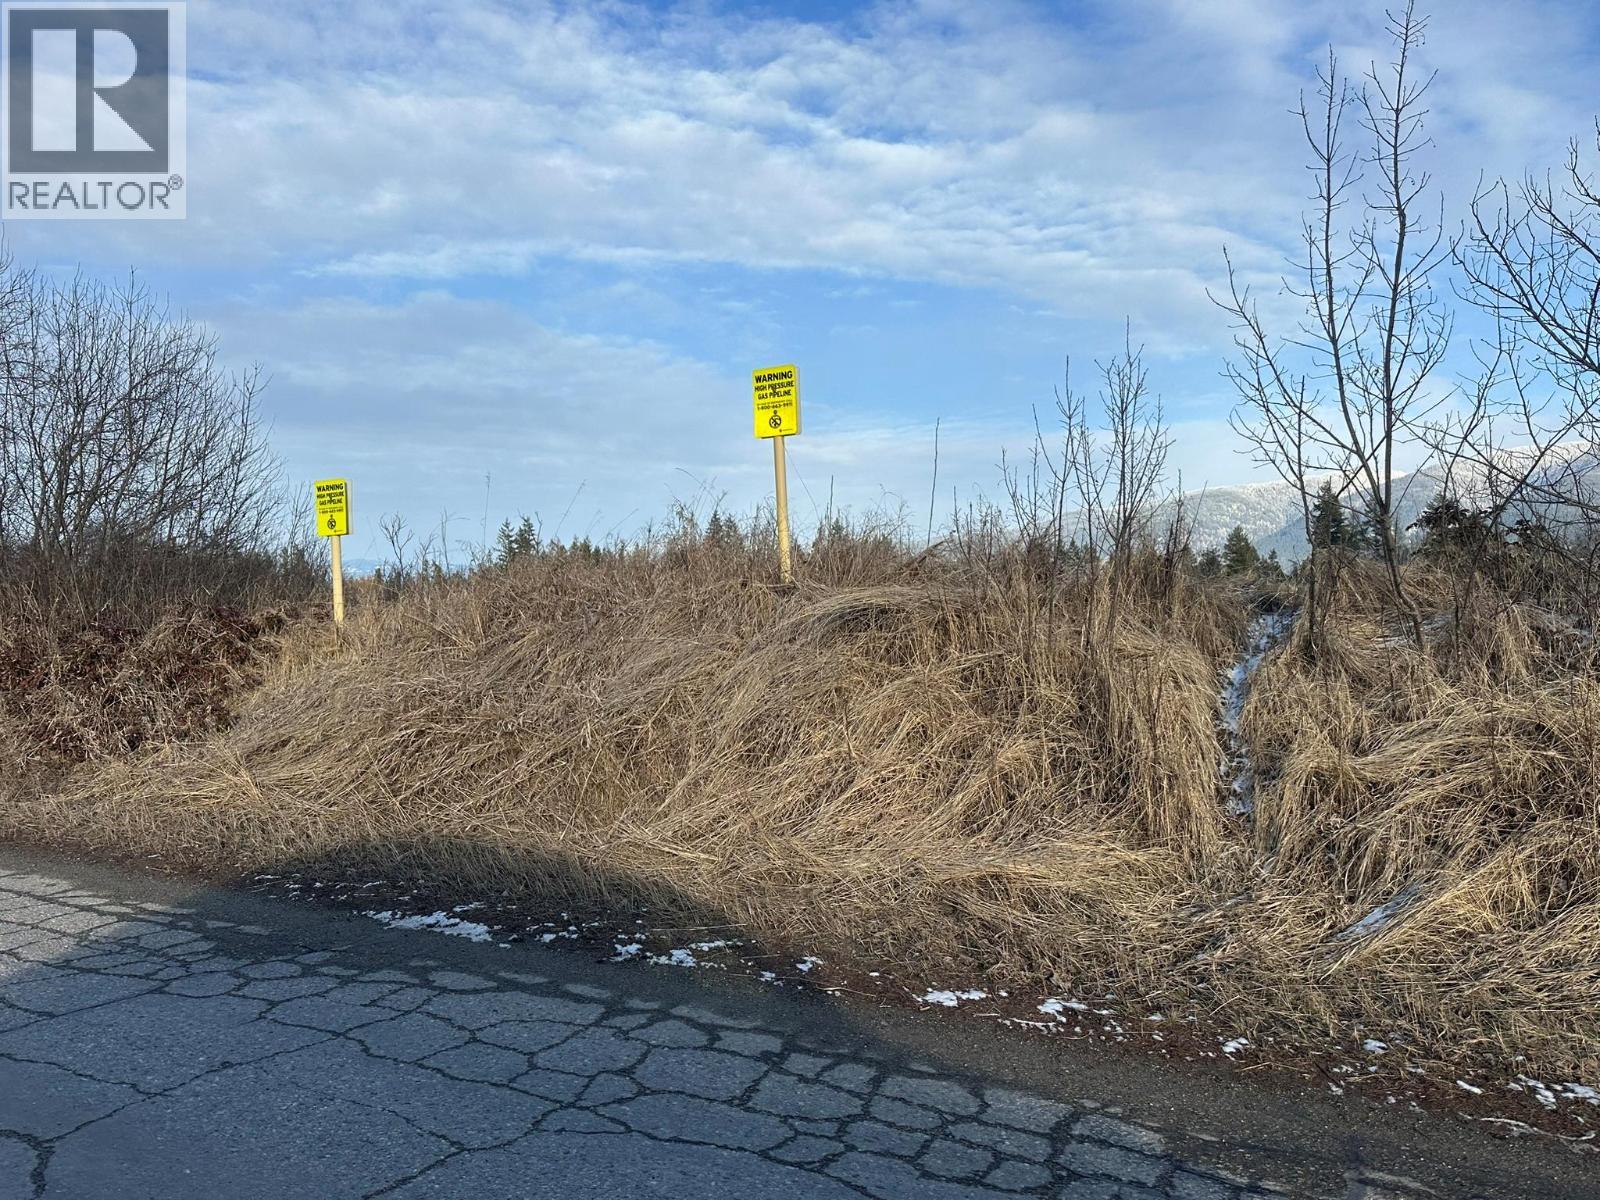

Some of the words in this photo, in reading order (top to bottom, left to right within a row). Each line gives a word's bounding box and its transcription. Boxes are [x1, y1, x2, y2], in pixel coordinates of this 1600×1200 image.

[755, 370, 793, 384] WARNING
[768, 381, 794, 390] PRESSURE
[769, 389, 791, 398] PIPELINE
[316, 483, 344, 492] WARNING
